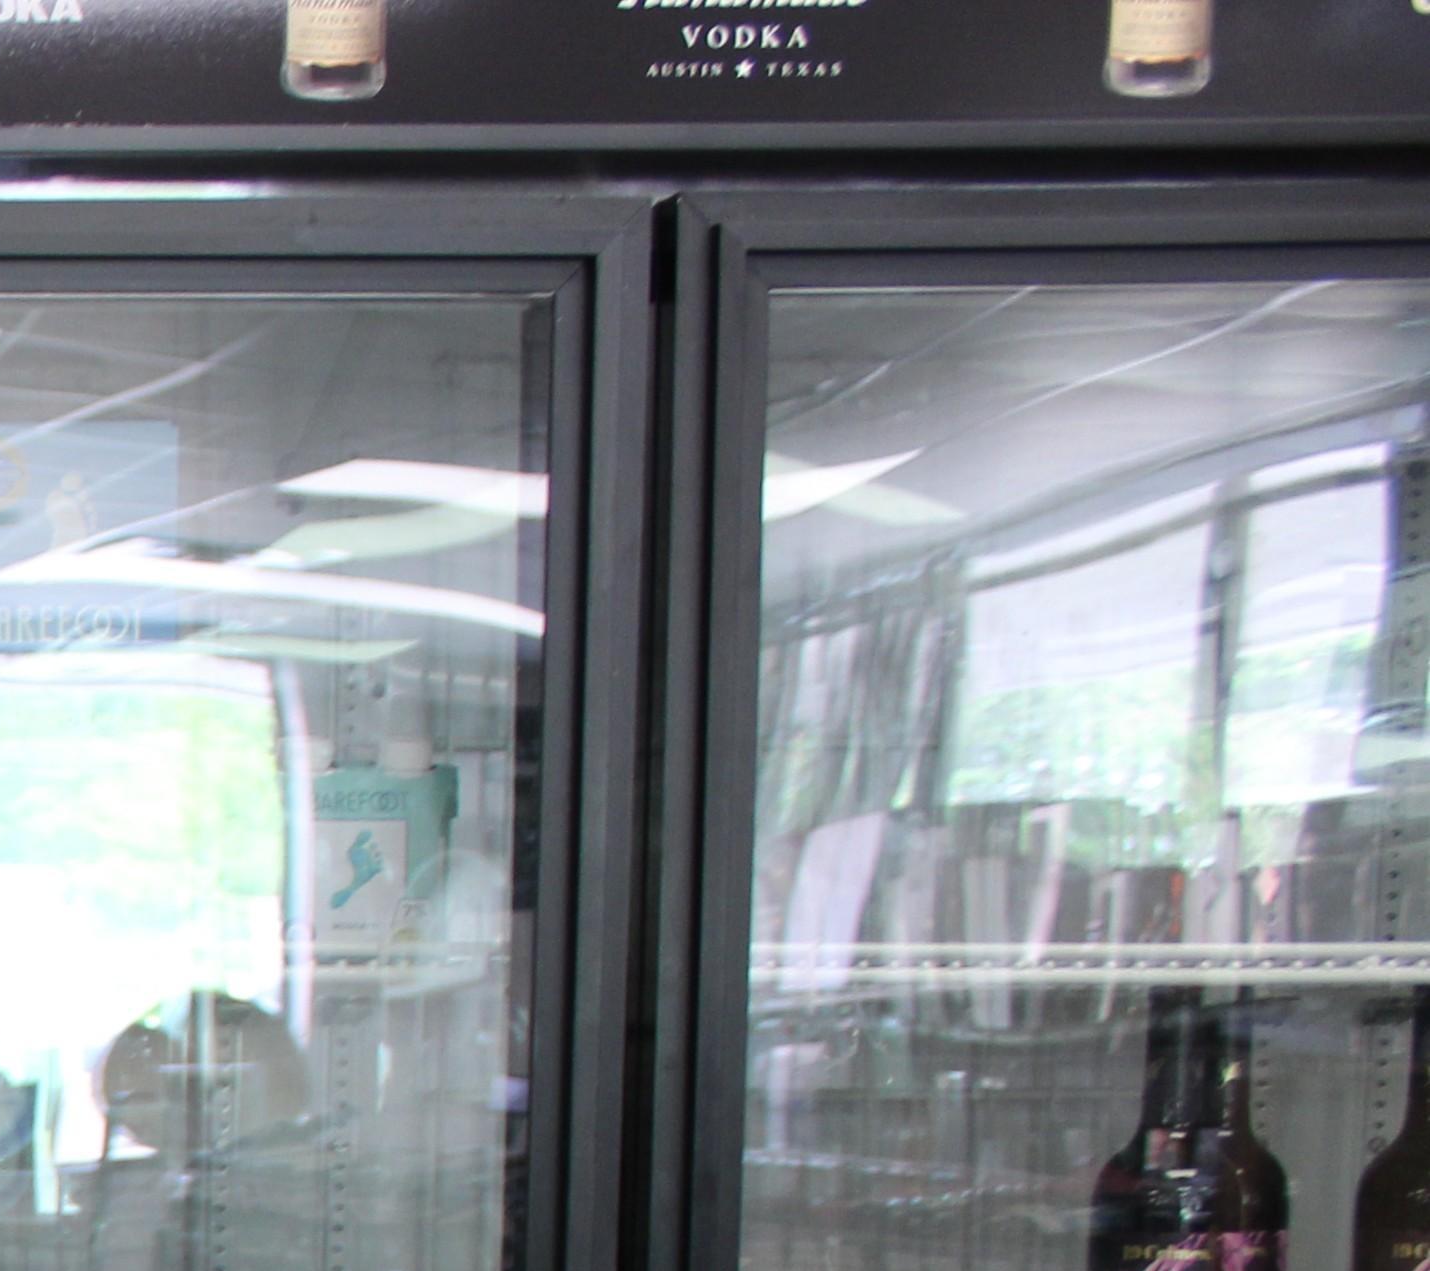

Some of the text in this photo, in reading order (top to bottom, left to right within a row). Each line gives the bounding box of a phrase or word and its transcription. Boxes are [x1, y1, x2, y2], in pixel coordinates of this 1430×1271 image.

[681, 23, 809, 49] VODKA
[645, 60, 844, 78] AUSTIN TEXAS
